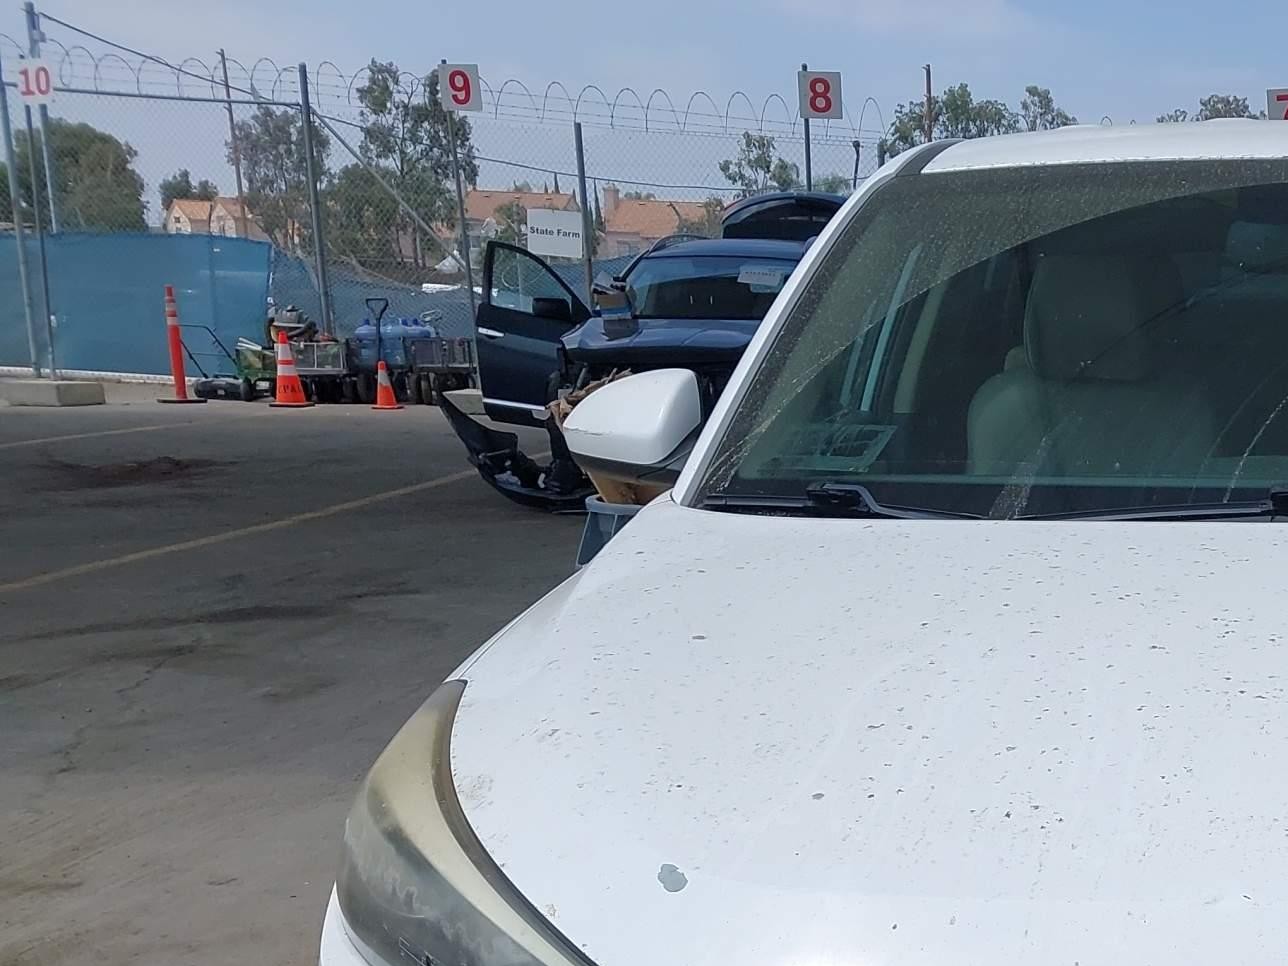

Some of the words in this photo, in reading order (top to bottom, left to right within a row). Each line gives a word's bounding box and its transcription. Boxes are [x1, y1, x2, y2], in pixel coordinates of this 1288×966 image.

[18, 66, 50, 96] 10
[449, 70, 471, 105] 9
[809, 77, 832, 113] 8
[530, 226, 554, 236] State
[557, 228, 580, 239] Farm
